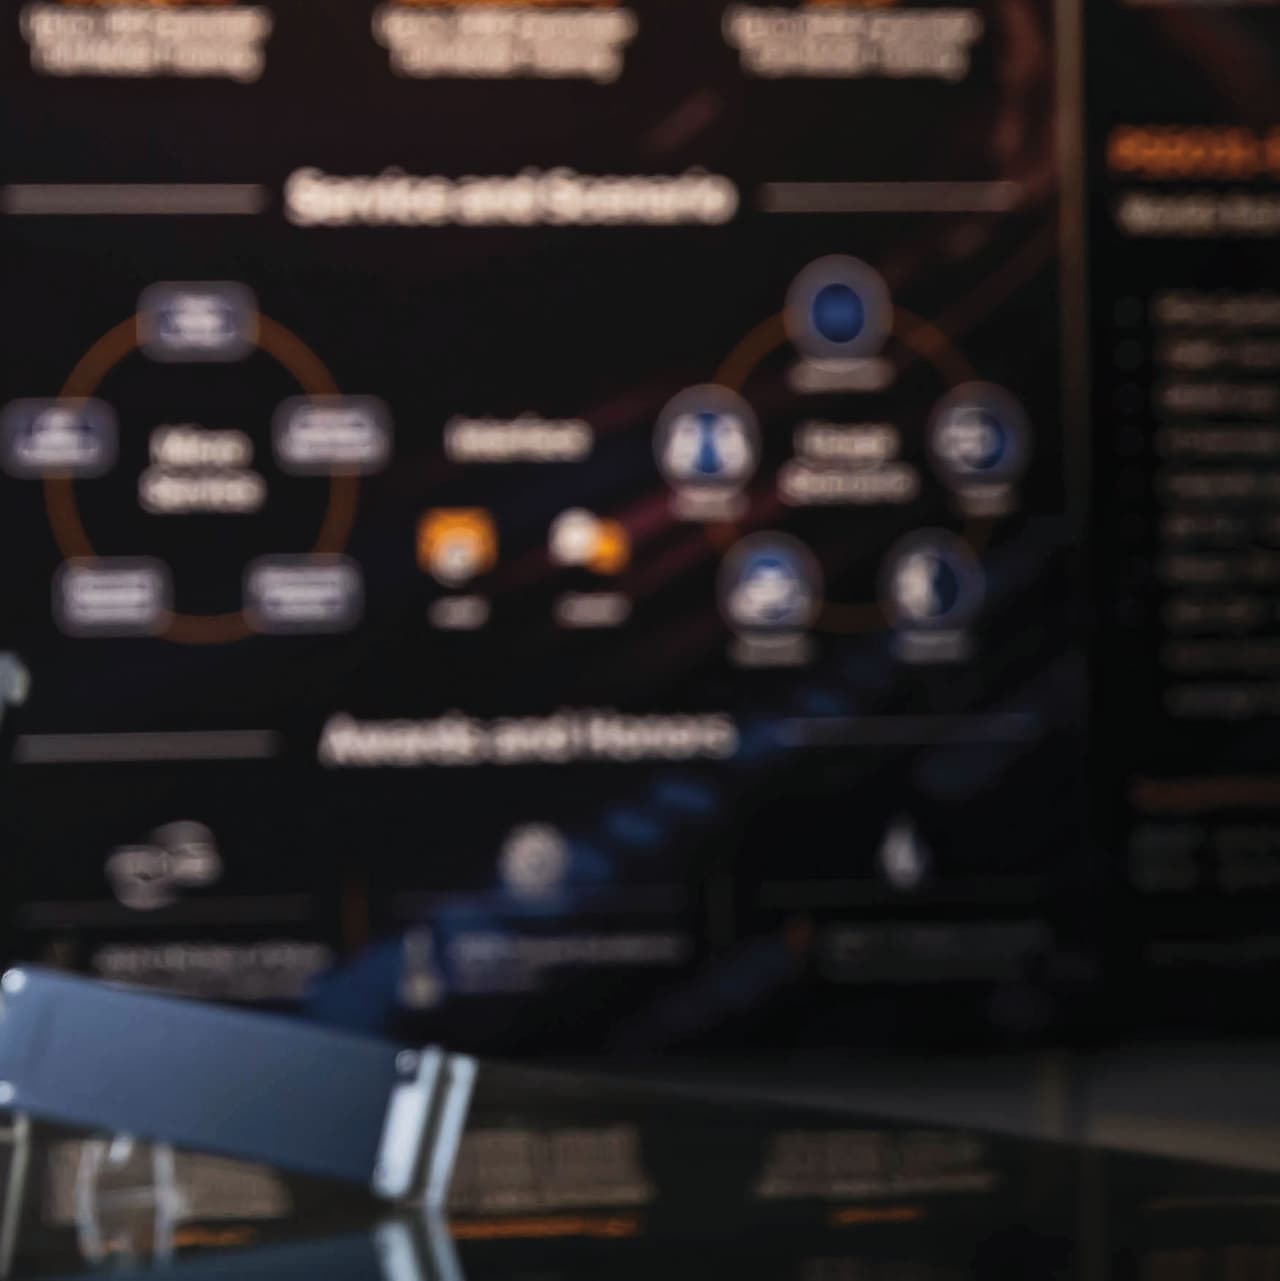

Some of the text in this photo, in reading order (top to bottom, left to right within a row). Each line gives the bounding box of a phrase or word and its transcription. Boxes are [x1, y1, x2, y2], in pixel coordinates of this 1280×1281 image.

[285, 166, 453, 227] Service
[454, 166, 543, 225] and
[319, 705, 739, 767] Awards and Honors
